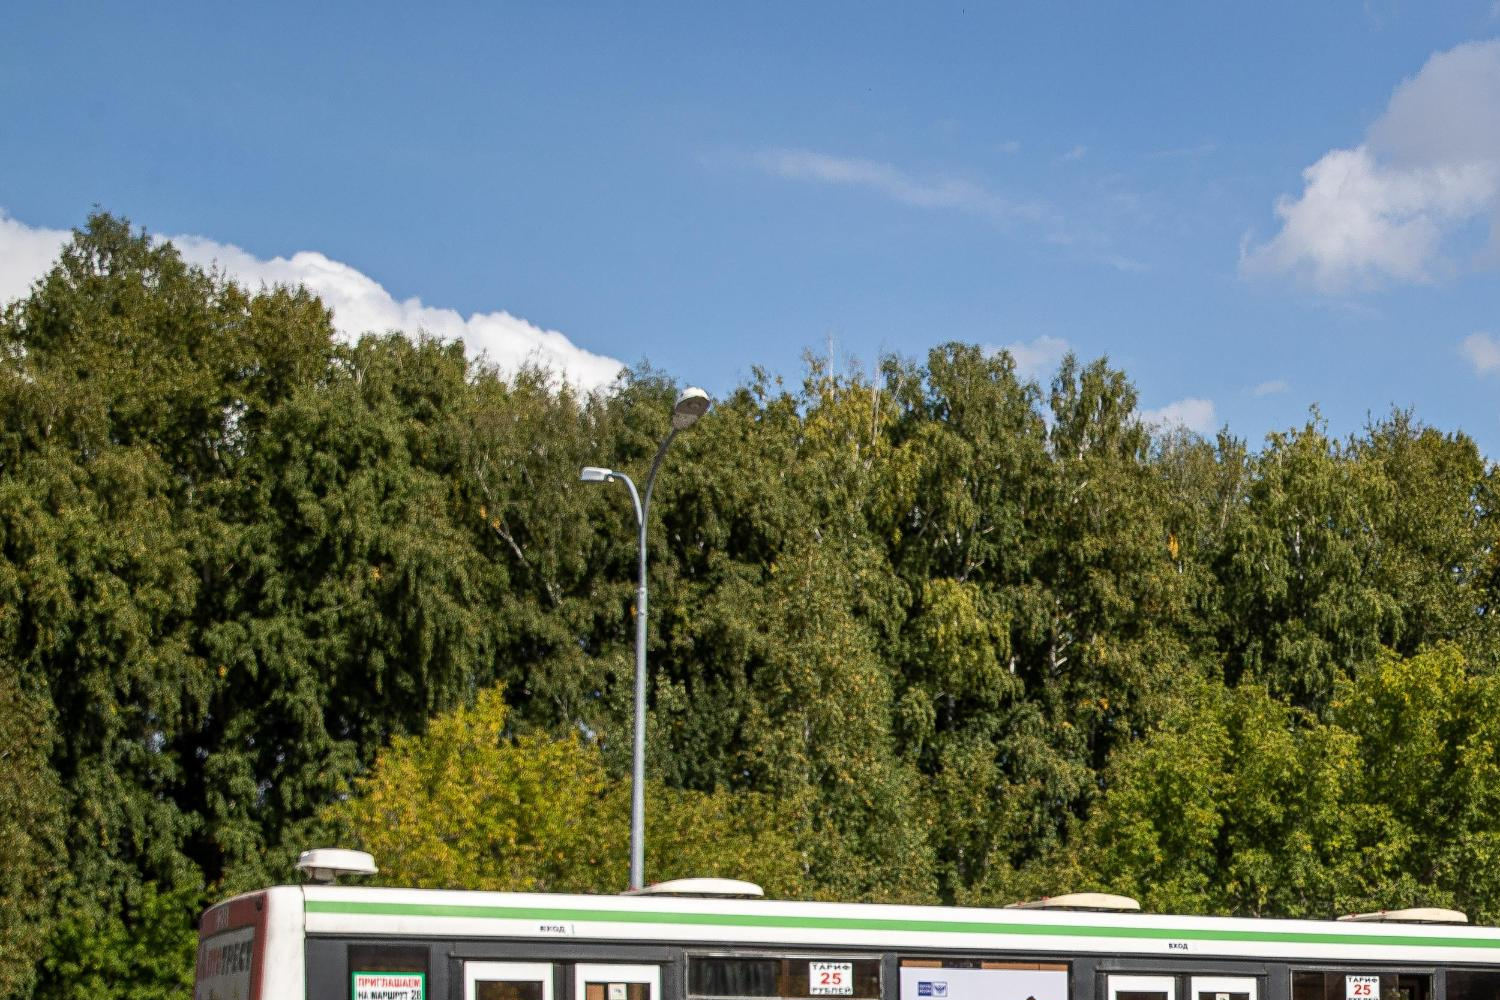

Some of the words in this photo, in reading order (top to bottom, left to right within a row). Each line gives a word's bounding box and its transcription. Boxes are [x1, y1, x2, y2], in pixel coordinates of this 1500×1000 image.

[1168, 943, 1189, 951] ВХОД
[358, 977, 421, 987] ПРИГЛАШАЕМ
[820, 972, 842, 985] 25
[1354, 984, 1371, 995] 25
[358, 991, 369, 1000] НА
[371, 991, 408, 1000] МАРШРУТ
